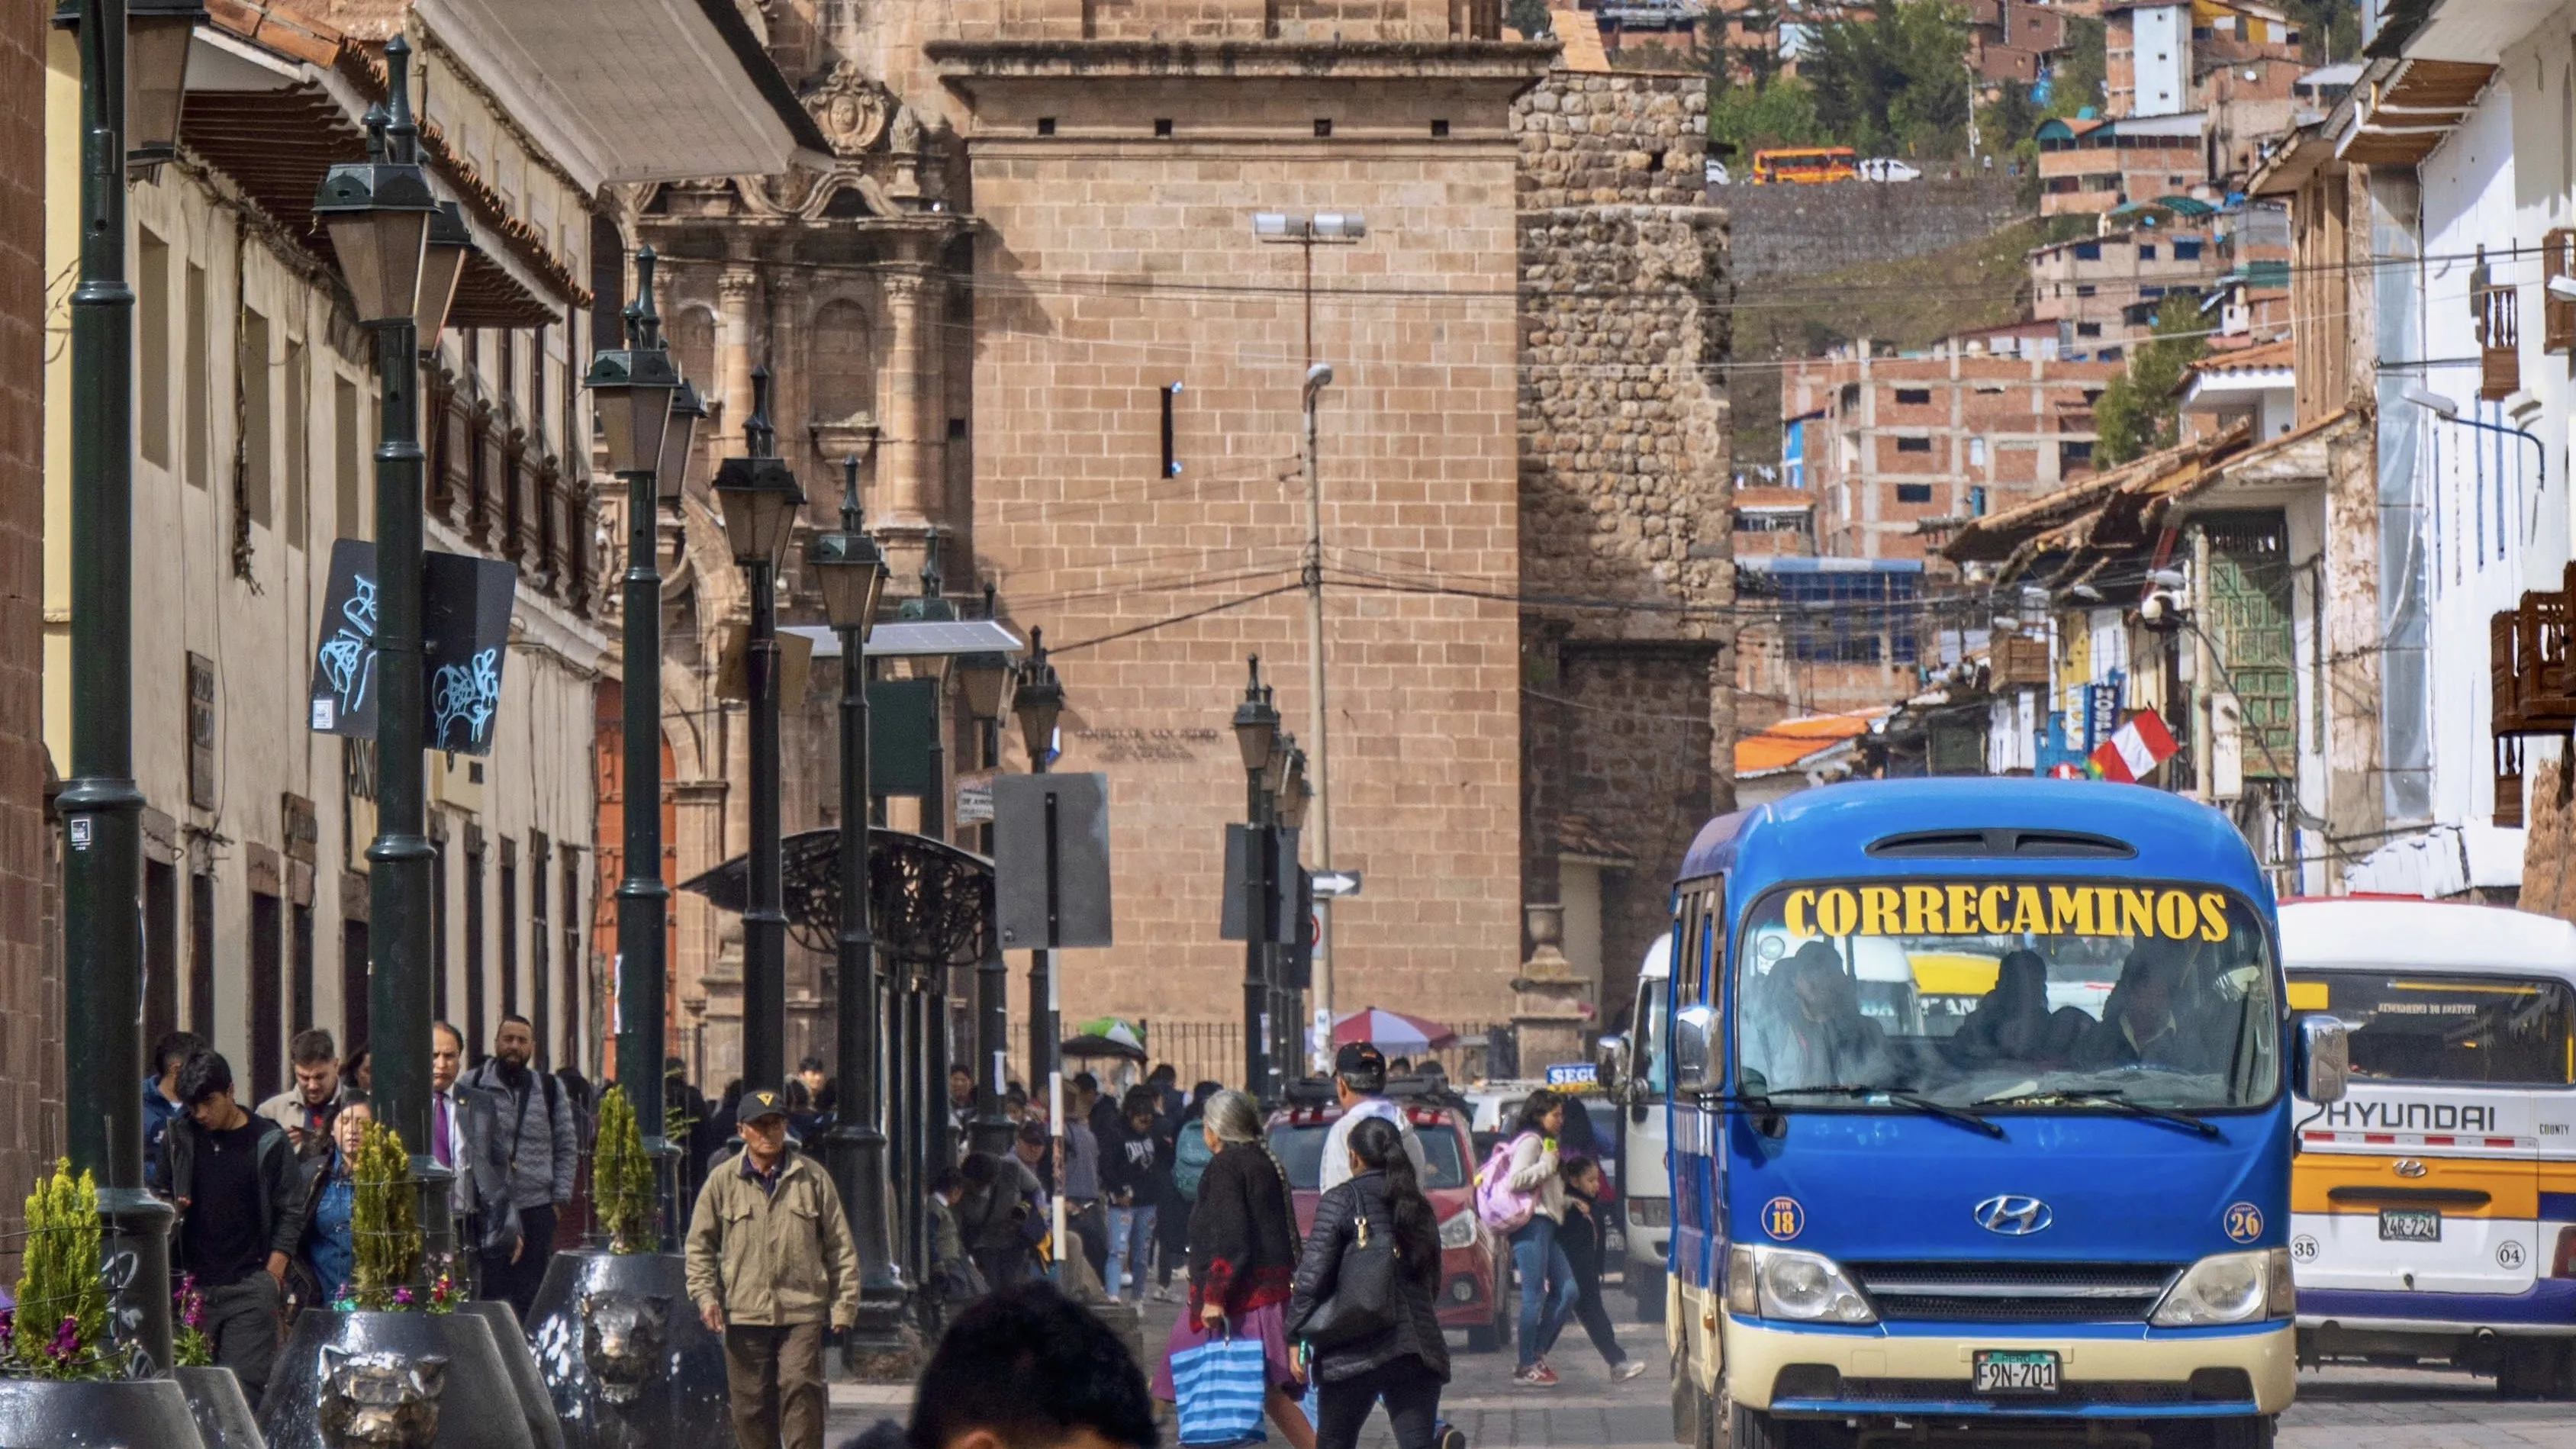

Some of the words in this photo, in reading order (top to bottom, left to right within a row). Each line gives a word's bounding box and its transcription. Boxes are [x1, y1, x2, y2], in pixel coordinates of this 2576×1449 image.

[1784, 884, 2230, 942] CORRECAMINOS
[2326, 1102, 2495, 1131] HYUNDAI
[2539, 1123, 2569, 1135] COUNTY
[1773, 1211, 1794, 1234] 18
[2231, 1212, 2259, 1237] 26
[2294, 1242, 2315, 1257] 35
[2500, 1249, 2520, 1264] 04
[1977, 1363, 2054, 1387] F9N-701
